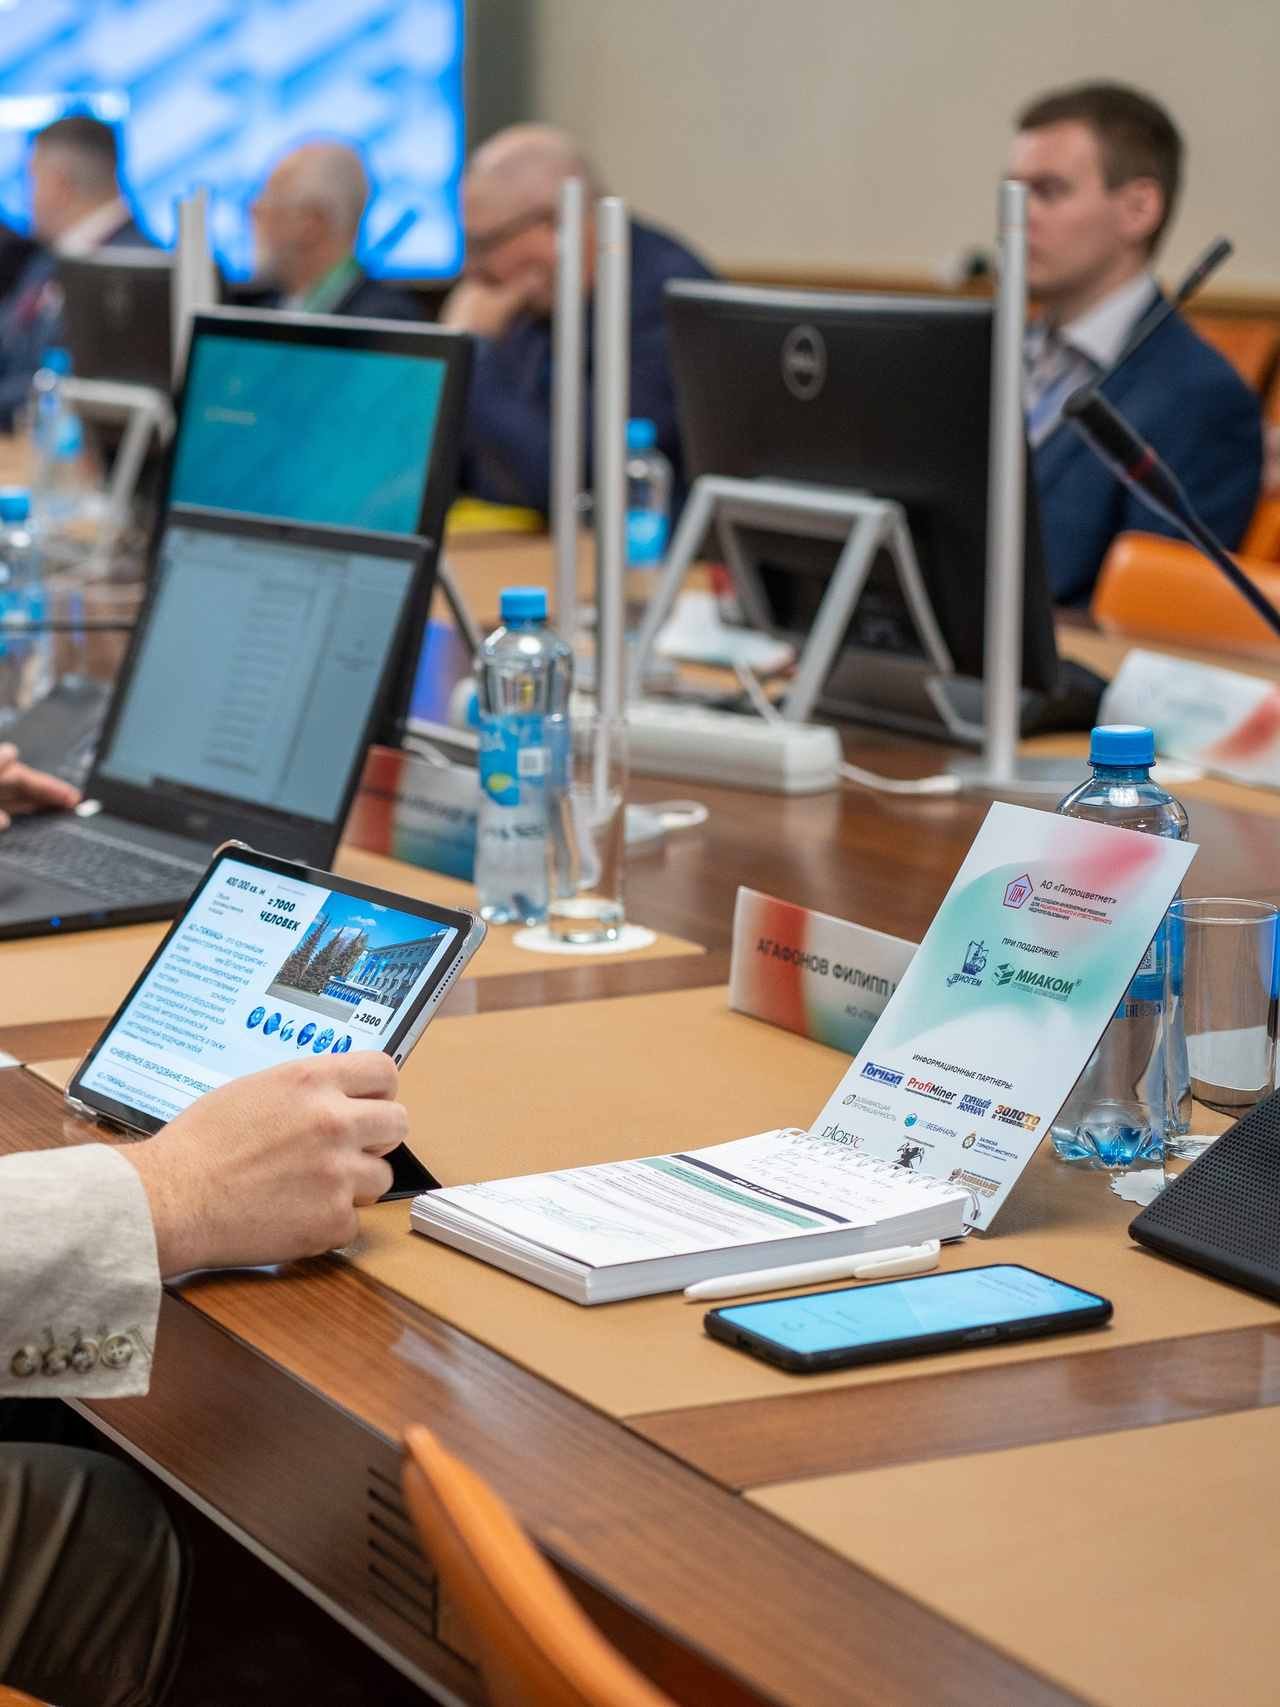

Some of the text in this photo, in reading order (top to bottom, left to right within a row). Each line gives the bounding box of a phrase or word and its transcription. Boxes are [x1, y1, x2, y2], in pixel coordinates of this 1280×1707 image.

[226, 876, 236, 886] 400
[237, 878, 250, 890] 000
[1040, 880, 1116, 904] АО «Гипроцветмет»
[274, 898, 296, 913] 7000
[260, 910, 301, 931] ЧЕЛОВЕК
[1028, 908, 1070, 920] НЕДРОПОЛЬЗОВАНИЯ
[1039, 904, 1073, 915] РАЦИОНАЛЬНОГО
[1077, 912, 1112, 924] ОТВЕТСТВЕННОГО
[1002, 938, 1060, 958] ПРИ ПОДДЕРЖКЕ:
[757, 938, 888, 996] АГАФОНОВ ФИЛИПП
[954, 974, 982, 986] ВИОГЕМ
[359, 1013, 382, 1026] 2500
[210, 1040, 226, 1050] также
[110, 1048, 144, 1066] КОНВЕЙЕРНОЕ
[143, 1060, 182, 1082] ОБОРУДОВАНИЕ
[912, 1054, 976, 1078] ИНФОРМАЦИОННЫЕ
[976, 1074, 1013, 1090] ПАРТНЕРЫ:
[860, 1074, 897, 1088] ПРОМЫШЛЕННОСТЬ
[908, 1078, 957, 1100] ProfiMiner
[856, 1096, 890, 1110] ДОБЫВАЮЩАЯ
[957, 1102, 985, 1116] ЖУРНАЛ
[962, 1094, 992, 1109] ГОРНЫЙ
[852, 1102, 896, 1121] ПРОМЫШЛЕННОСТЬ
[995, 1105, 1040, 1126] ЗОЛОТО
[822, 1123, 864, 1148] ГЛОБУС
[918, 1120, 958, 1137] ГЕОВЕБИНАРЫ
[976, 1142, 994, 1151] ГОРНОГО
[995, 1149, 1018, 1158] ИНСТИТУТА
[980, 1138, 998, 1146] ЗАПИСКИ
